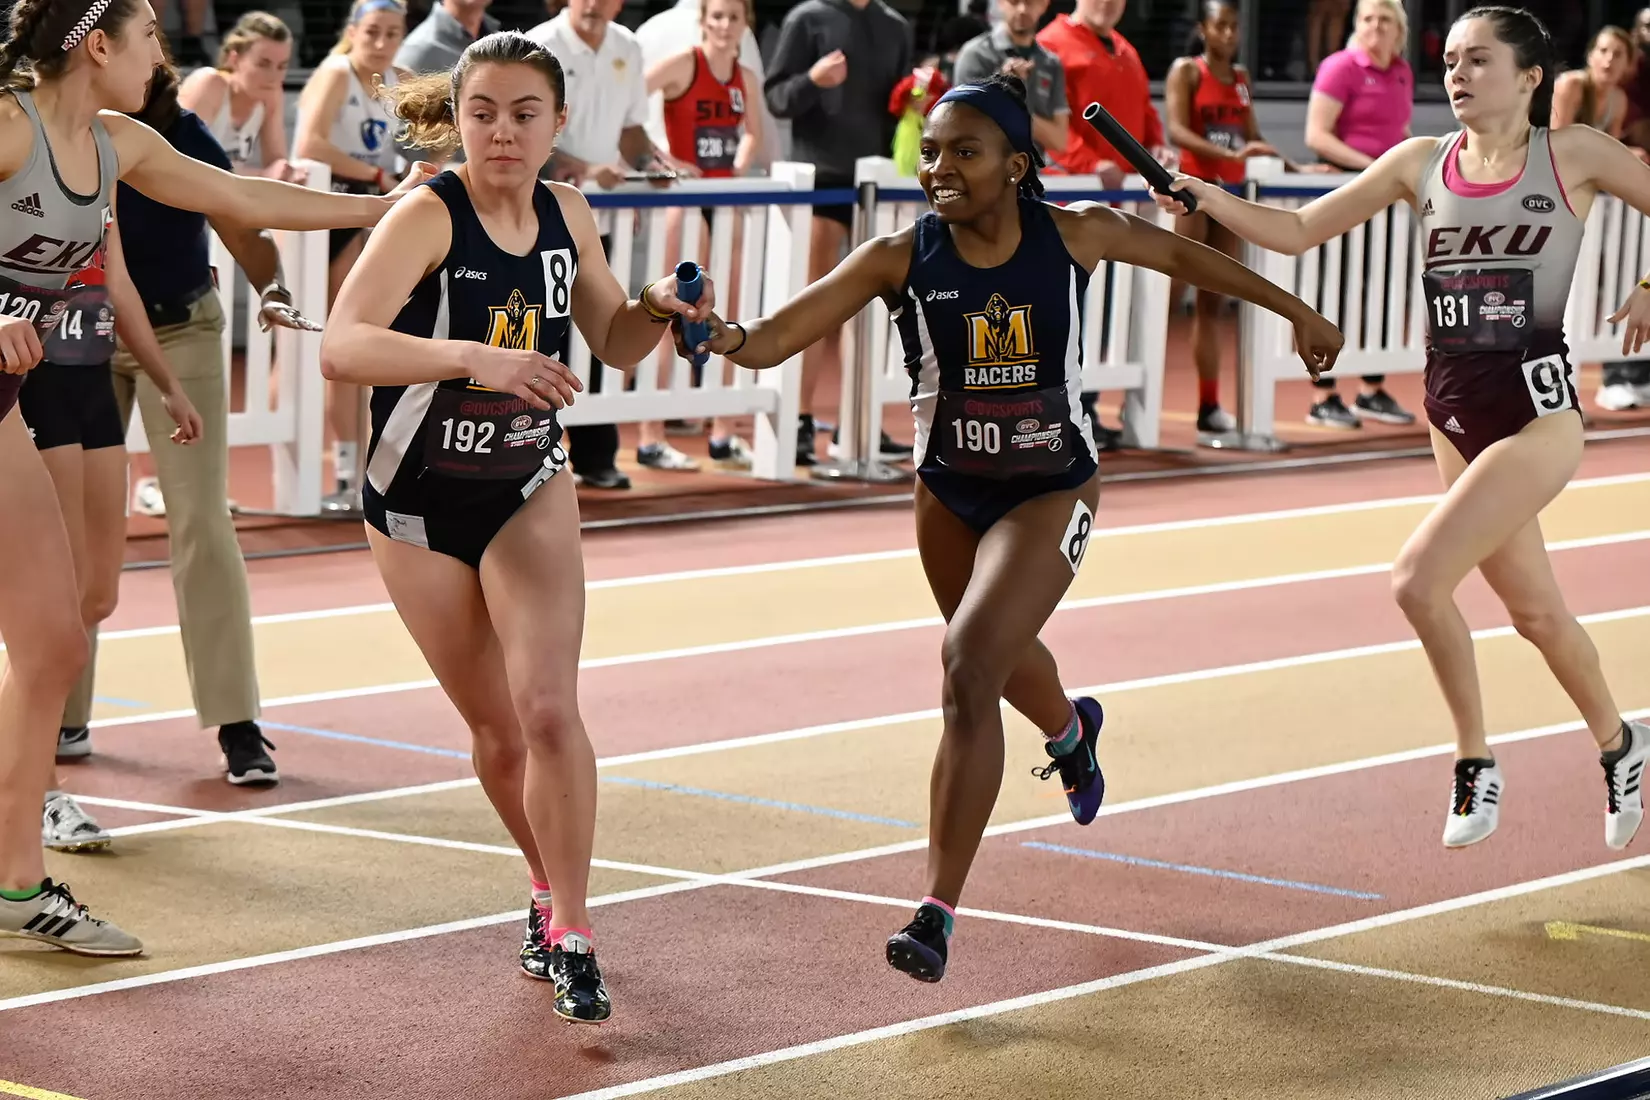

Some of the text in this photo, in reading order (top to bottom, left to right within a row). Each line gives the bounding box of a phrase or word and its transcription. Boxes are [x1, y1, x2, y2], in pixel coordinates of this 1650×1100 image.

[11, 201, 45, 218] adidas
[1528, 200, 1549, 209] OVC
[1427, 224, 1553, 259] EKU
[465, 269, 488, 281] asics
[549, 253, 569, 315] 8
[936, 290, 959, 300] asics
[1434, 294, 1469, 328] 131
[484, 304, 542, 351] M
[962, 304, 1033, 363] M
[964, 364, 1037, 385] RACERS
[1531, 361, 1564, 410] 9
[442, 418, 496, 454] 192
[503, 425, 550, 442] CHAMPIONSHIP
[952, 418, 1001, 454] 190
[1011, 429, 1062, 444] CHAMPIONSHIP
[1069, 512, 1091, 565] 8
